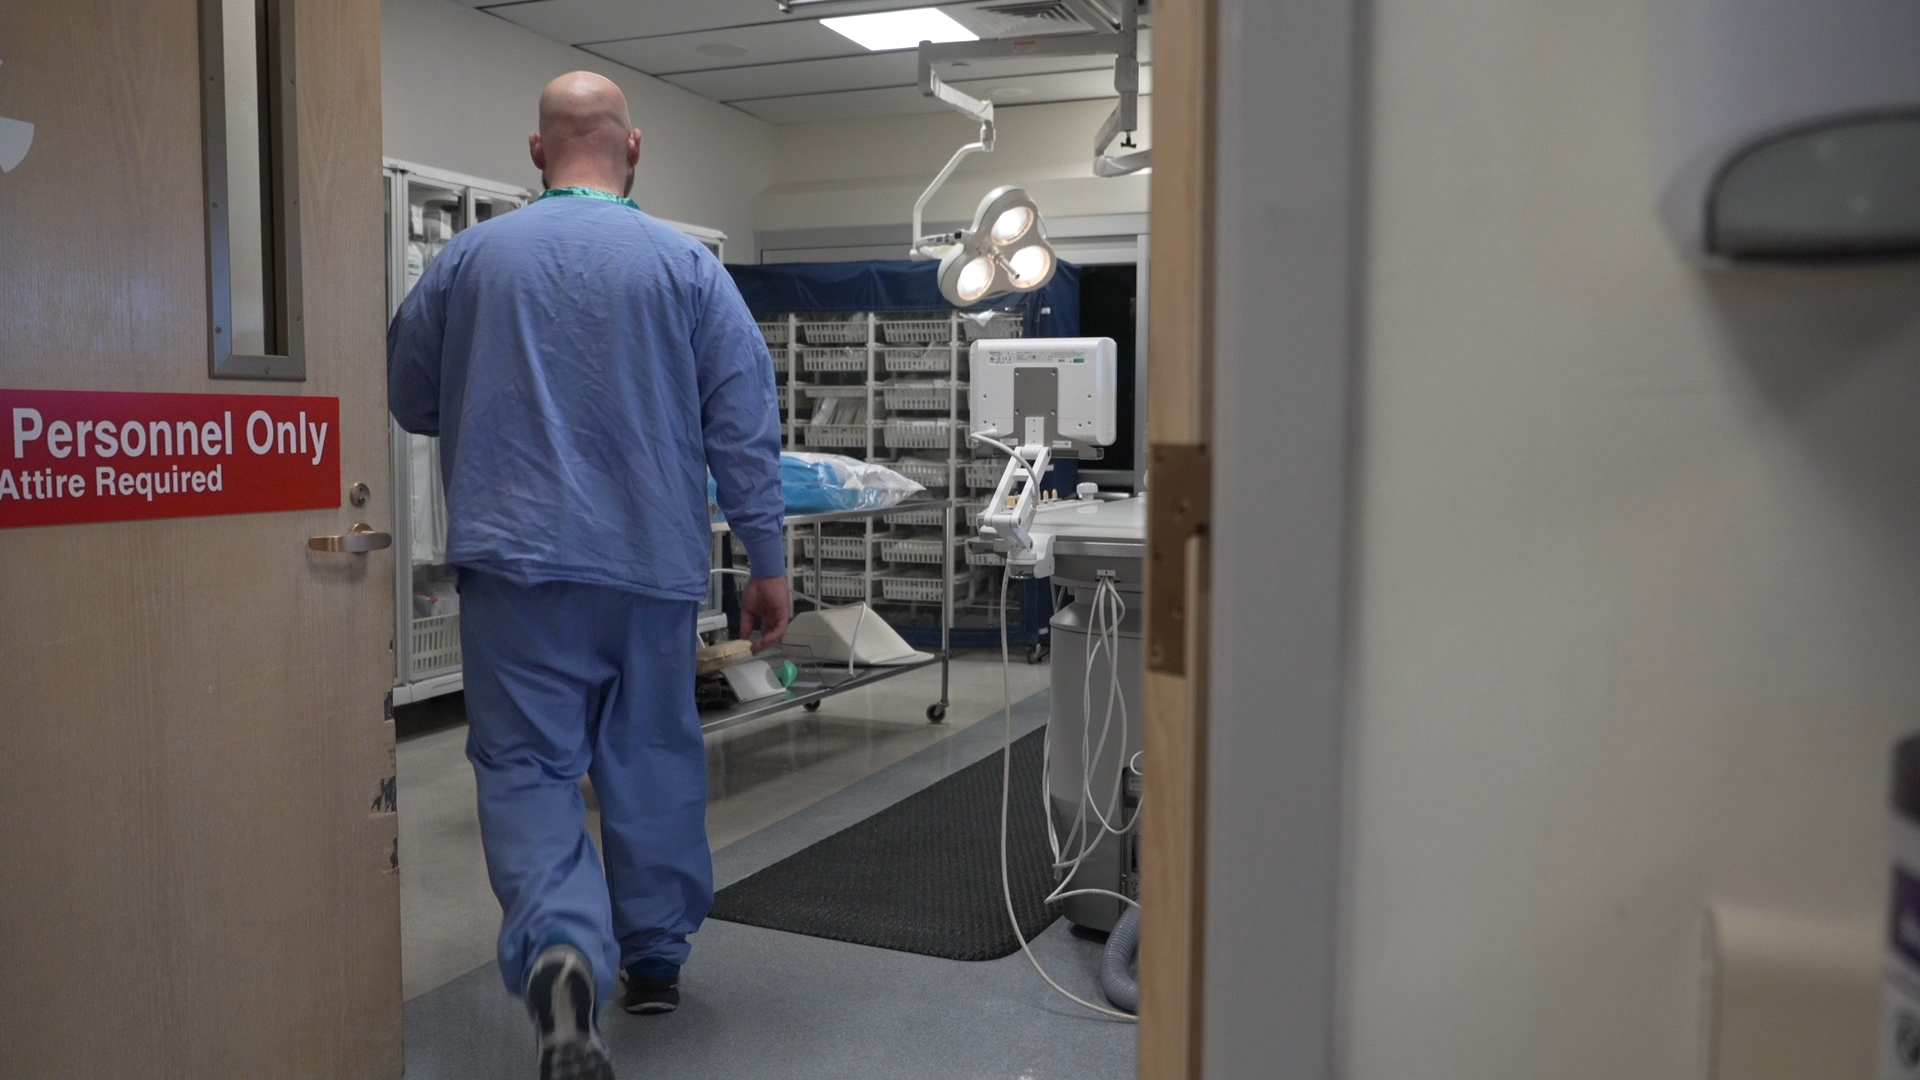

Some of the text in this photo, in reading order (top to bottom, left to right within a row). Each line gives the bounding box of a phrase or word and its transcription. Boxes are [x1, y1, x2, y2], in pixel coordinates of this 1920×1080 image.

[12, 407, 328, 466] Personnel Only
[0, 463, 223, 502] Attire Required
